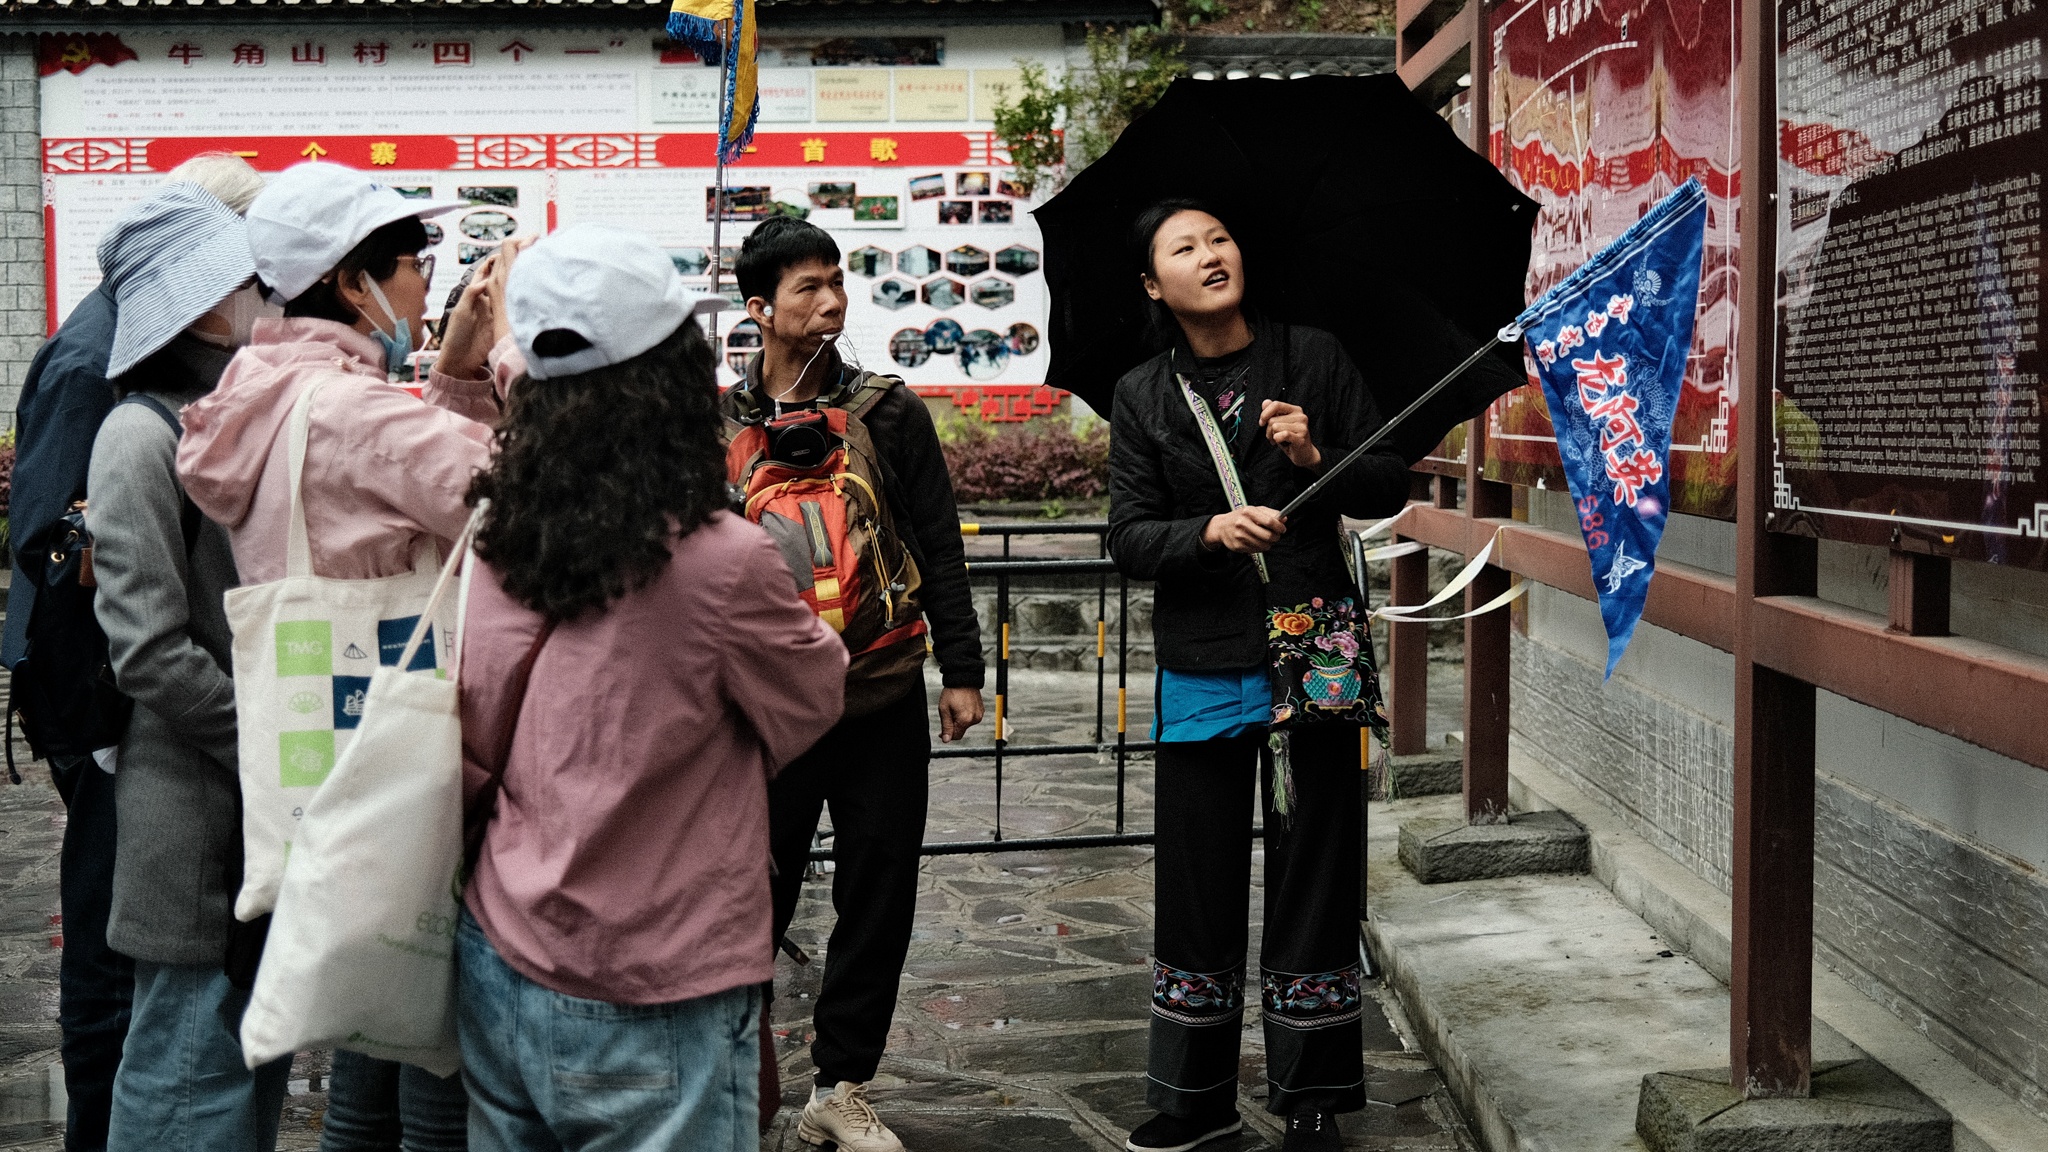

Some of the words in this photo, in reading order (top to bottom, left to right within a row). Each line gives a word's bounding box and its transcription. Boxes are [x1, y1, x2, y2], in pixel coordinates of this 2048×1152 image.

[167, 37, 625, 67] 牛角山村“四个一”
[233, 140, 398, 166] 一个寨
[1940, 191, 1960, 210] villages
[1961, 186, 1979, 201] under
[2031, 170, 2040, 184] Its
[1935, 208, 1952, 226] village
[1954, 206, 1961, 222] by
[1964, 203, 1973, 216] the
[1940, 223, 1956, 237] Forest
[1958, 219, 1984, 237] coverage
[1986, 213, 1998, 227] rate
[2001, 211, 2008, 224] of
[2027, 205, 2032, 218] is
[2035, 207, 2039, 217] a
[1985, 227, 2004, 243] which
[2006, 223, 2039, 242] preserves
[1959, 251, 1965, 263] of
[1969, 249, 1978, 262] the
[2002, 239, 2028, 259] villages
[2032, 237, 2039, 250] in
[1940, 270, 1948, 282] the
[1949, 267, 1963, 284] great
[1965, 265, 1976, 278] wall
[1977, 264, 1983, 276] of
[2002, 259, 2008, 272] in
[2010, 254, 2039, 271] Western
[1966, 281, 1976, 293] the
[1978, 278, 1994, 295] great
[2012, 273, 2024, 287] and
[2027, 271, 2038, 284] the
[1953, 299, 1958, 310] is
[1961, 297, 1970, 309] full
[1973, 296, 1979, 308] of
[2018, 287, 2038, 302] which
[1942, 315, 1951, 327] the
[1952, 313, 1965, 326] Miao
[1967, 310, 1987, 327] people
[2013, 304, 2037, 319] faithful
[1964, 327, 1974, 339] and
[2023, 320, 2037, 334] with
[1941, 345, 1949, 356] Tea
[1947, 375, 1955, 387] tea
[1956, 375, 1966, 386] and
[1968, 374, 1983, 386] other
[1984, 373, 1998, 385] local
[2030, 374, 2037, 383] as
[2008, 404, 2028, 416] center
[2031, 404, 2039, 416] of
[1572, 349, 1663, 508] 龙阿英
[2006, 421, 2018, 432] and
[2020, 421, 2039, 433] other
[1953, 436, 1966, 447] Miao
[1968, 436, 1980, 451] long
[2009, 437, 2020, 449] and
[2022, 437, 2039, 449] bons
[1947, 454, 1955, 462] are
[2025, 453, 2040, 469] jobs
[1971, 467, 1981, 479] and
[1578, 494, 1610, 550] 586
[285, 640, 323, 656] TMG
